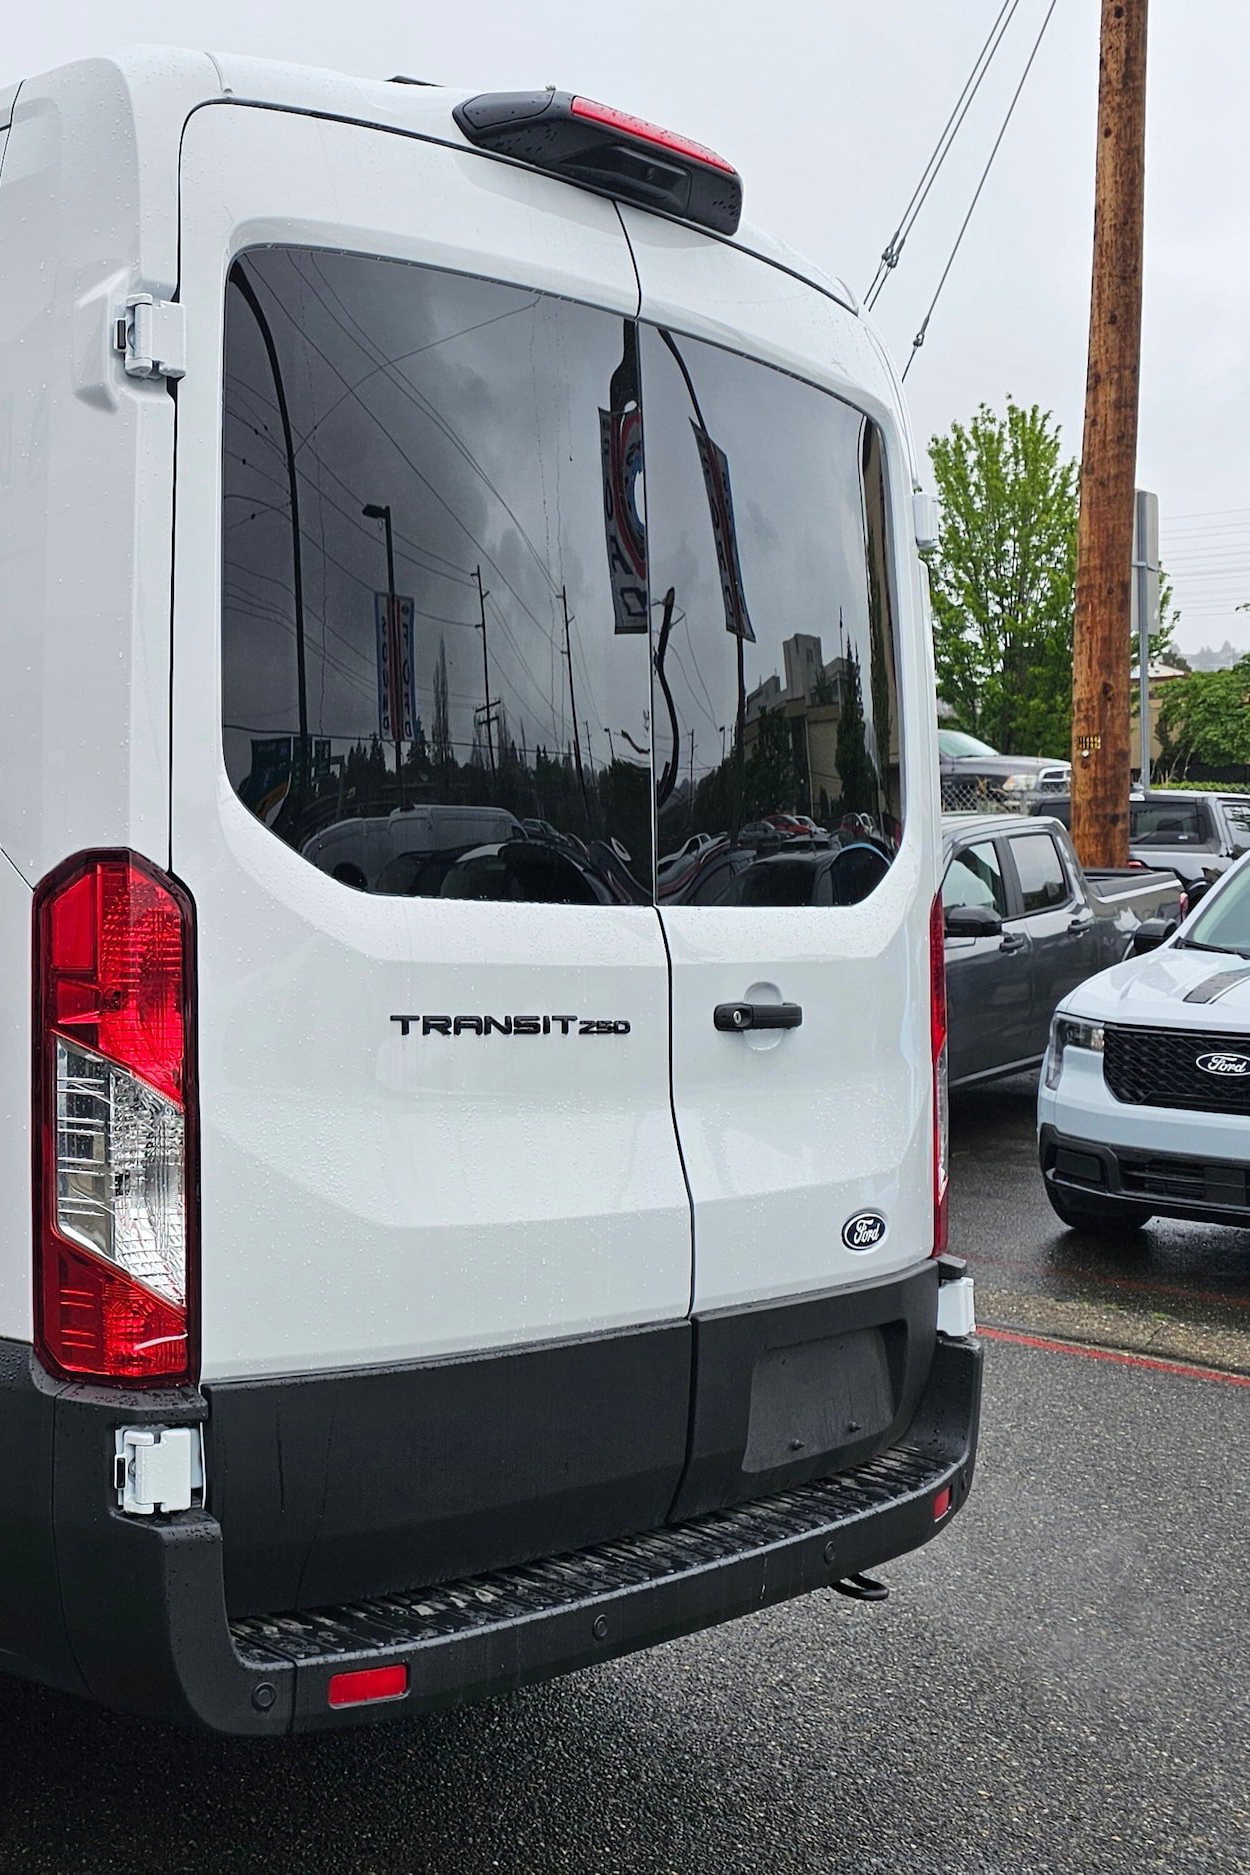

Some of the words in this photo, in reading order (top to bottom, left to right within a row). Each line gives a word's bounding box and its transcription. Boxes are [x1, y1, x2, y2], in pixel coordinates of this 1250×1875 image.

[390, 1015, 578, 1036] TRANSIT
[1207, 1055, 1247, 1073] Ford
[853, 1218, 881, 1244] Ford
